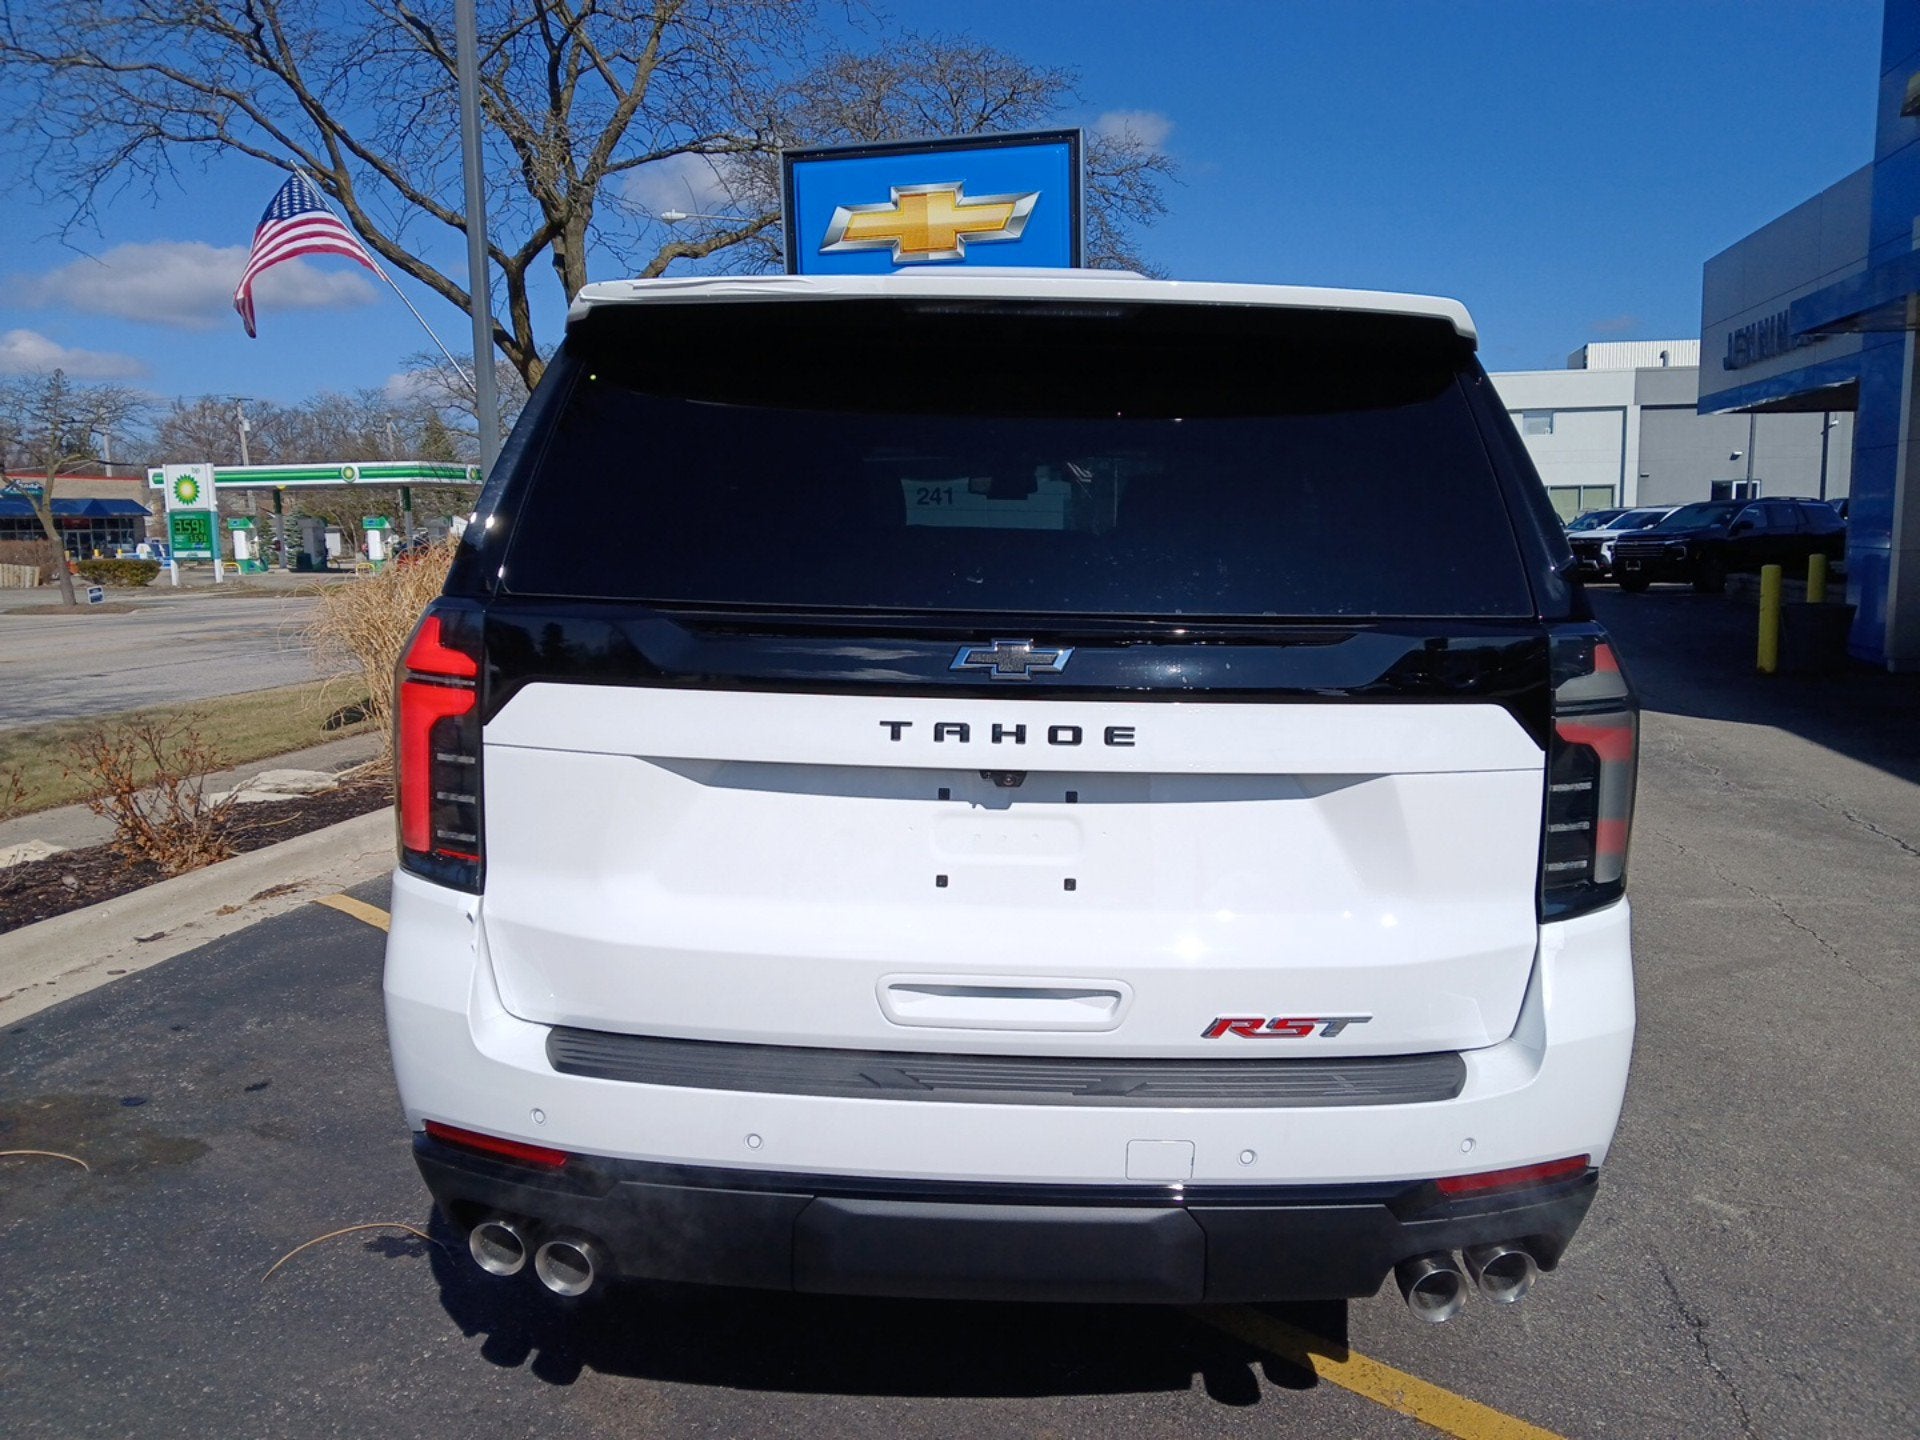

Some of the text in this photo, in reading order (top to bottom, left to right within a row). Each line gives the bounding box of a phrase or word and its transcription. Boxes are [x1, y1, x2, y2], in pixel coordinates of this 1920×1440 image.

[916, 487, 953, 505] 241
[879, 720, 1136, 747] TAHOE
[1200, 1015, 1373, 1040] RST
